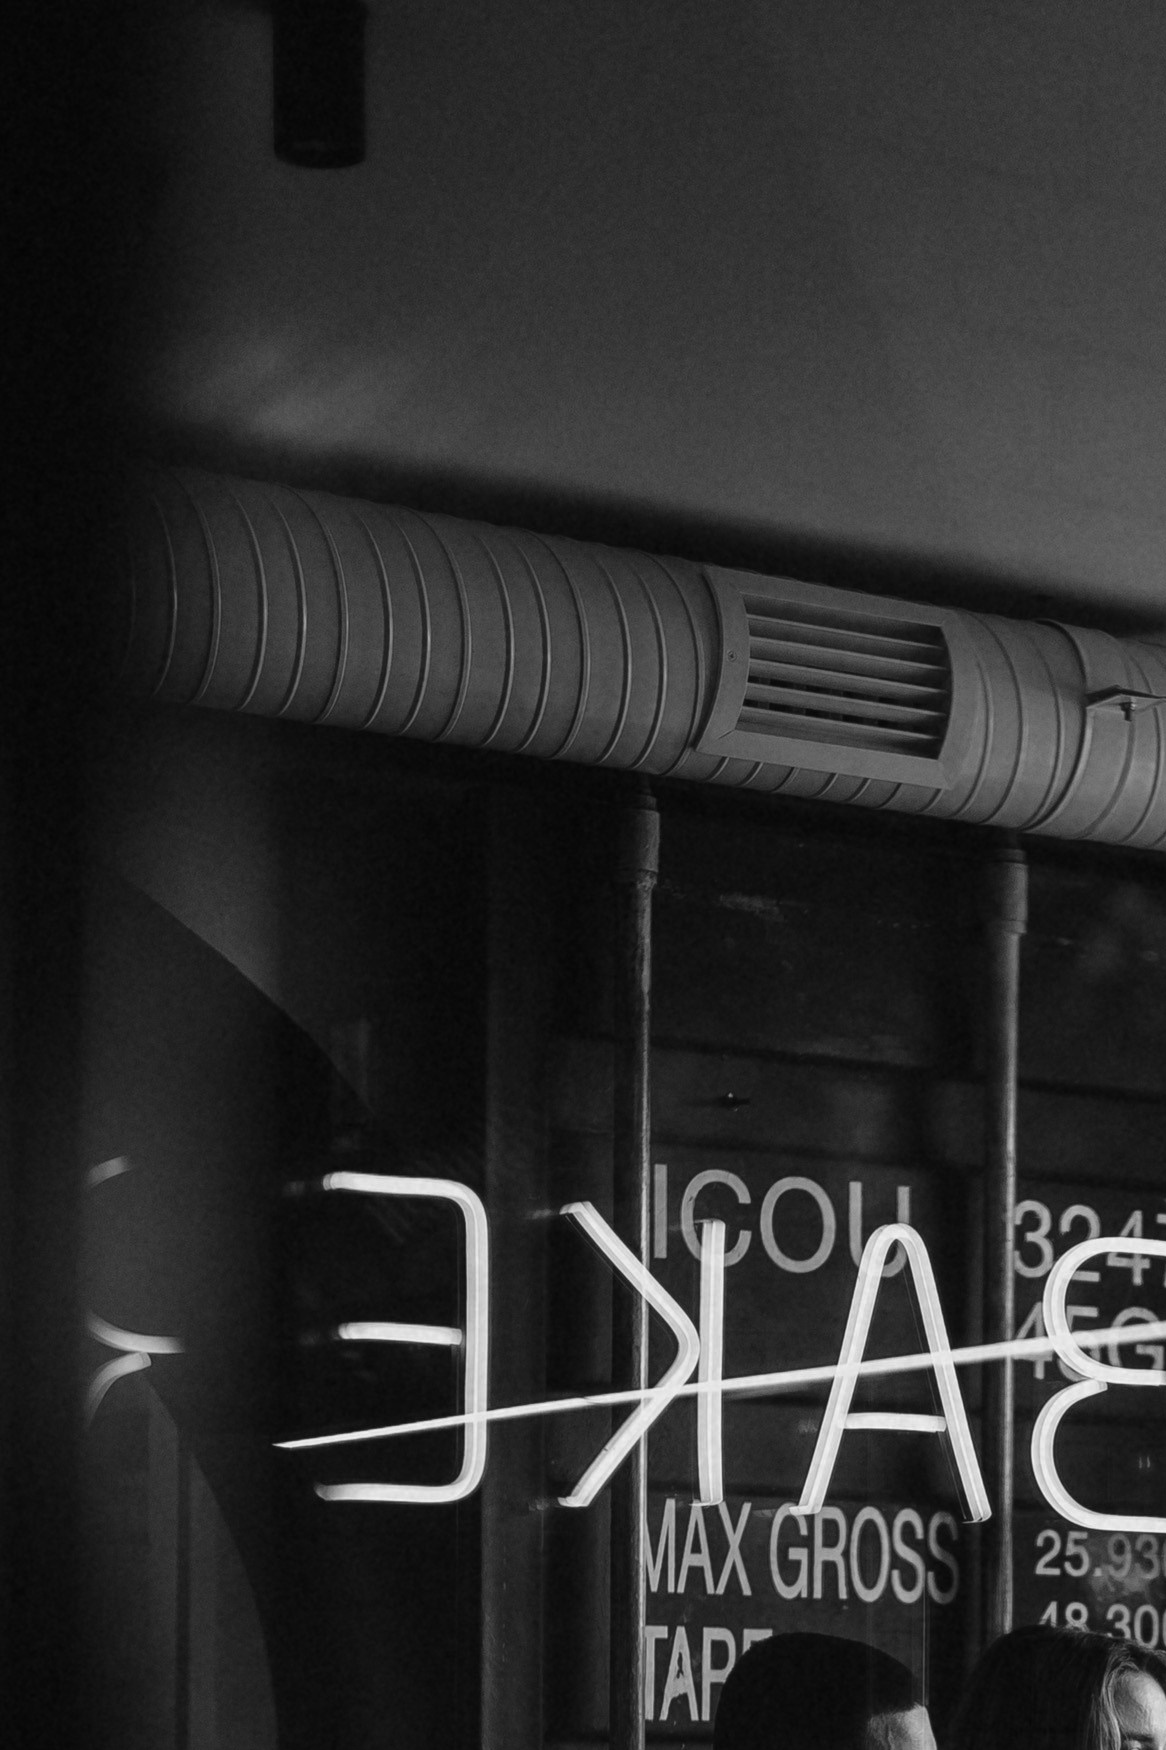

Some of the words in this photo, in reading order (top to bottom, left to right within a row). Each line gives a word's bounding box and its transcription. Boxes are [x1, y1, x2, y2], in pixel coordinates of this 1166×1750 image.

[653, 1163, 911, 1279] ICOU
[645, 1498, 752, 1597] MAX
[769, 1502, 960, 1605] GROSS
[644, 1624, 774, 1722] TAR
